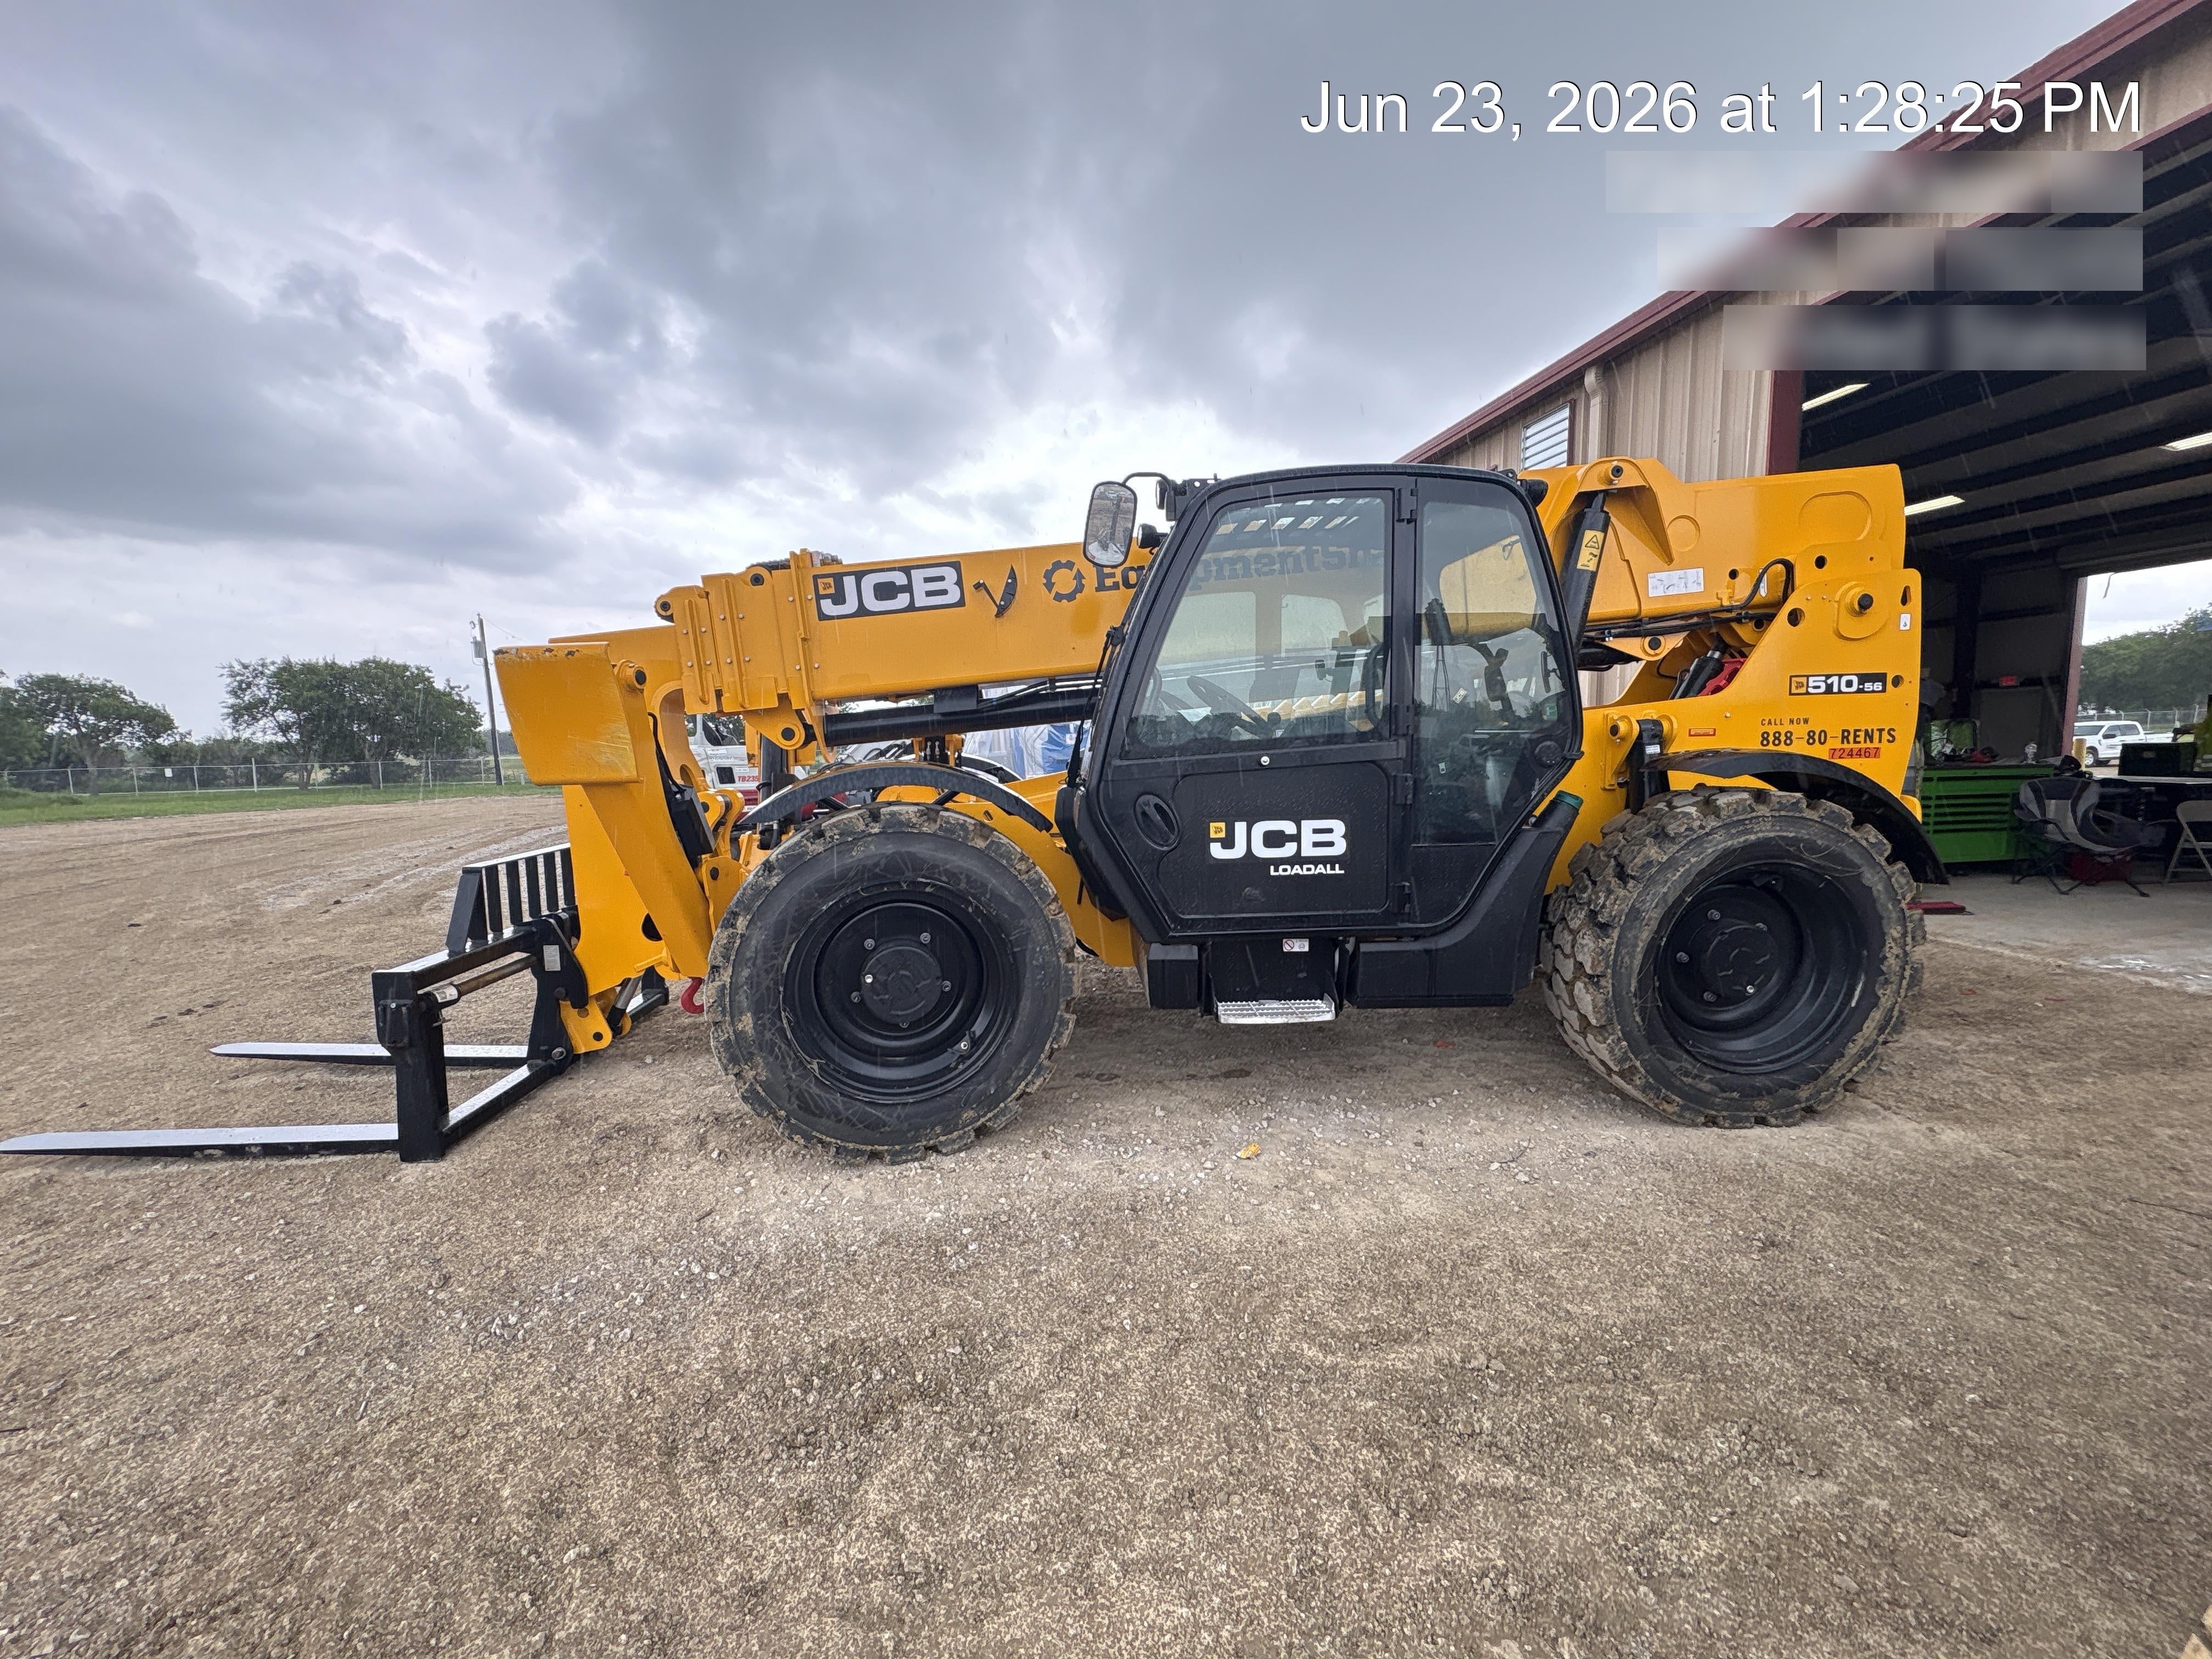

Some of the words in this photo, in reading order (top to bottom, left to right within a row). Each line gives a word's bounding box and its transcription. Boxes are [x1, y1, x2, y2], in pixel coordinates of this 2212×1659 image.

[820, 566, 961, 616] JCB
[1808, 675, 1882, 693] 510-56
[1760, 718, 1784, 726] CALL
[1789, 717, 1810, 725] NOW
[1760, 728, 1897, 747] 888-80-RENTS
[1830, 747, 1880, 759] 724467
[1210, 819, 1347, 859] JCB
[1270, 864, 1345, 876] LOADALL
